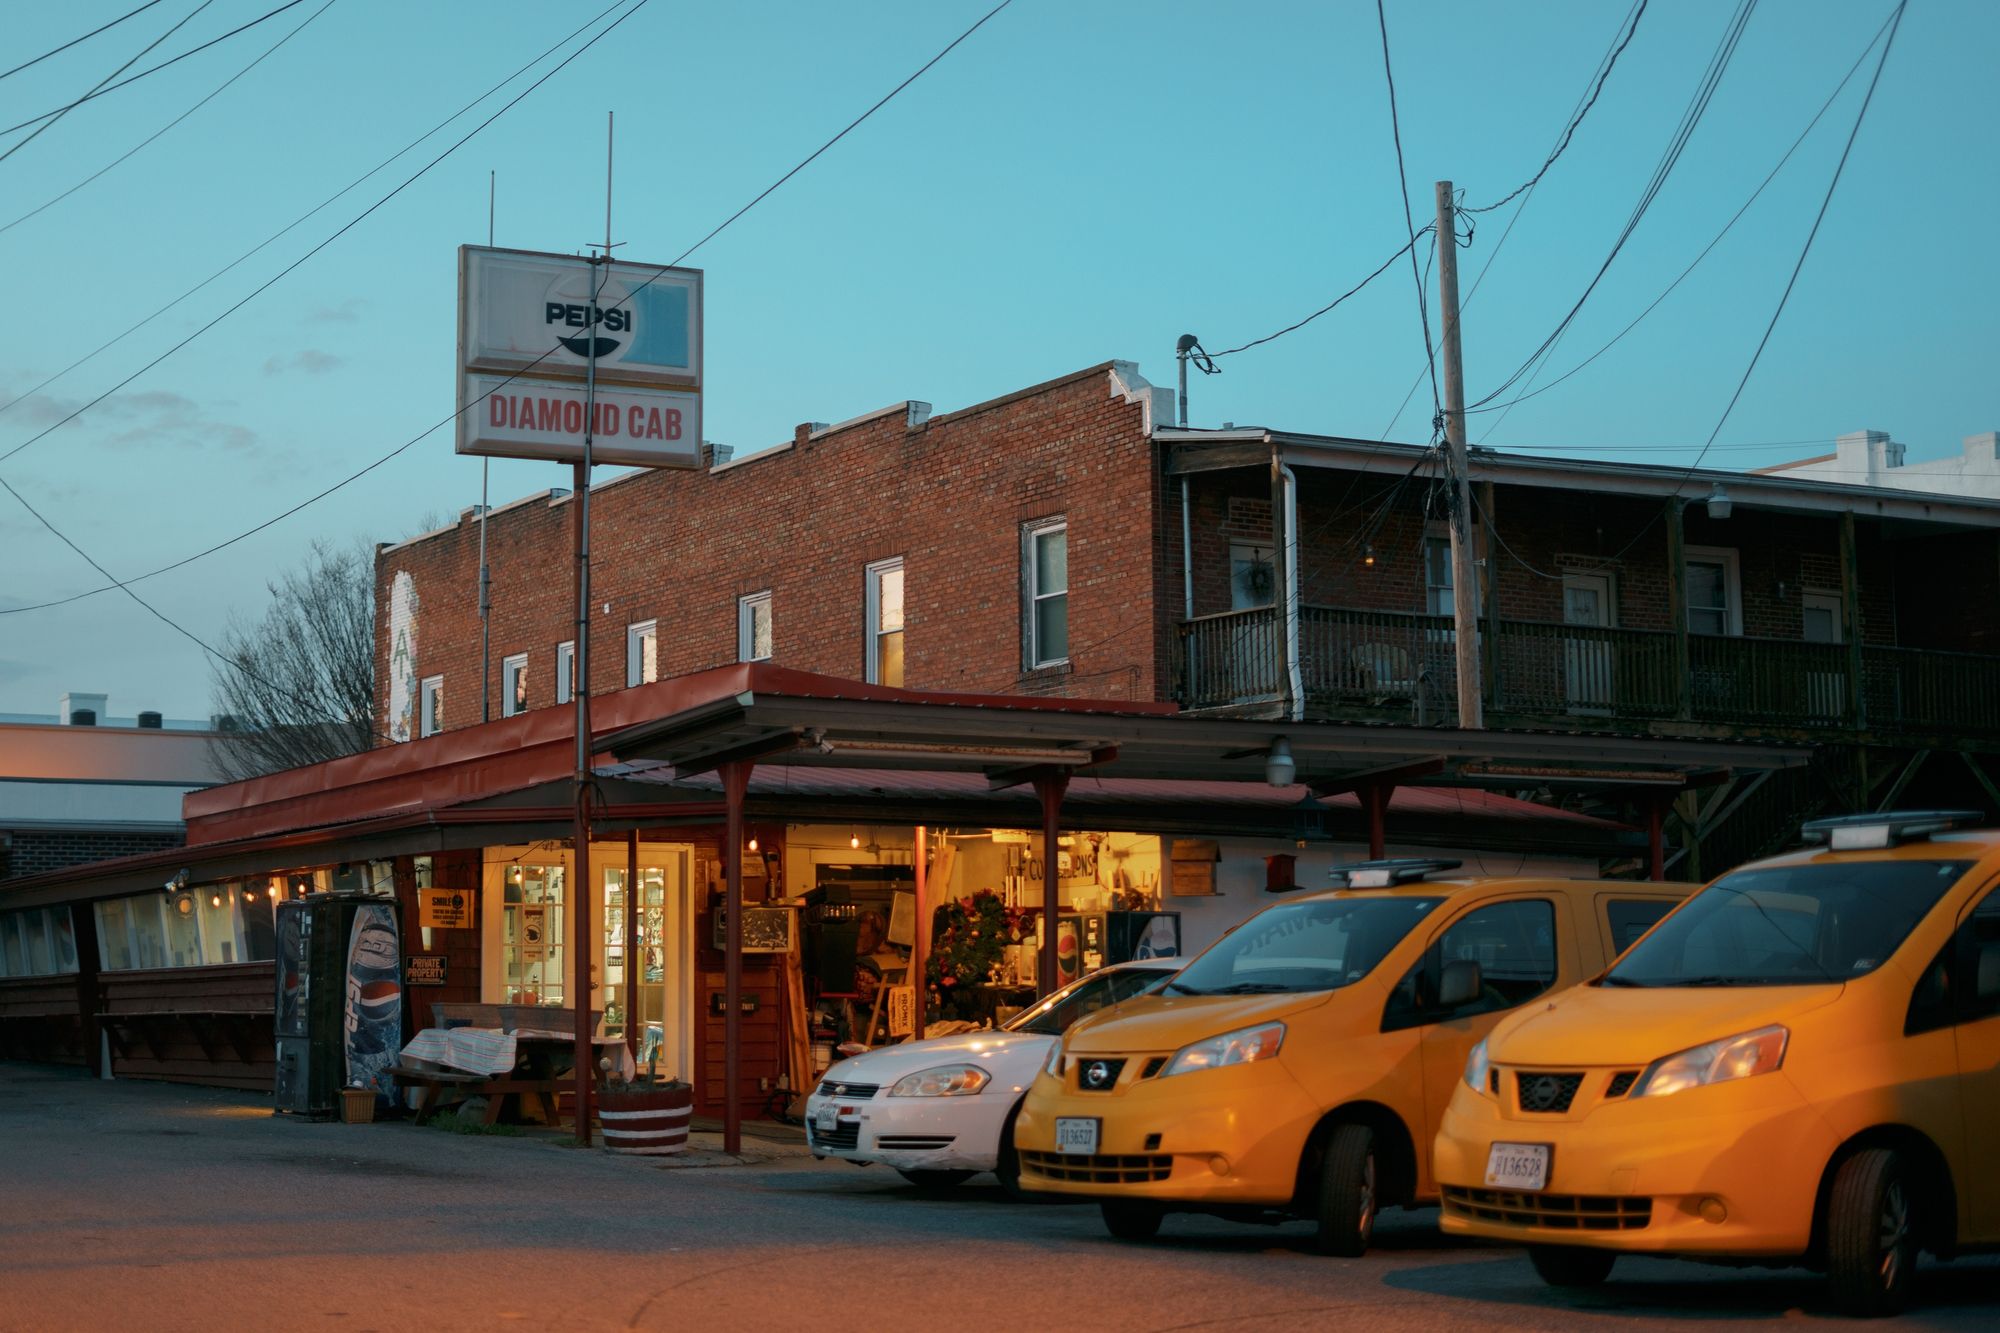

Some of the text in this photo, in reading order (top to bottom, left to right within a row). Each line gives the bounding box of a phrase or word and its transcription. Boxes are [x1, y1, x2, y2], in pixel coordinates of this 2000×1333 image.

[546, 302, 631, 332] PEPSI
[490, 395, 683, 441] DIAMOND CAB
[408, 968, 445, 978] PROPERTY
[412, 958, 441, 968] PRIVATE
